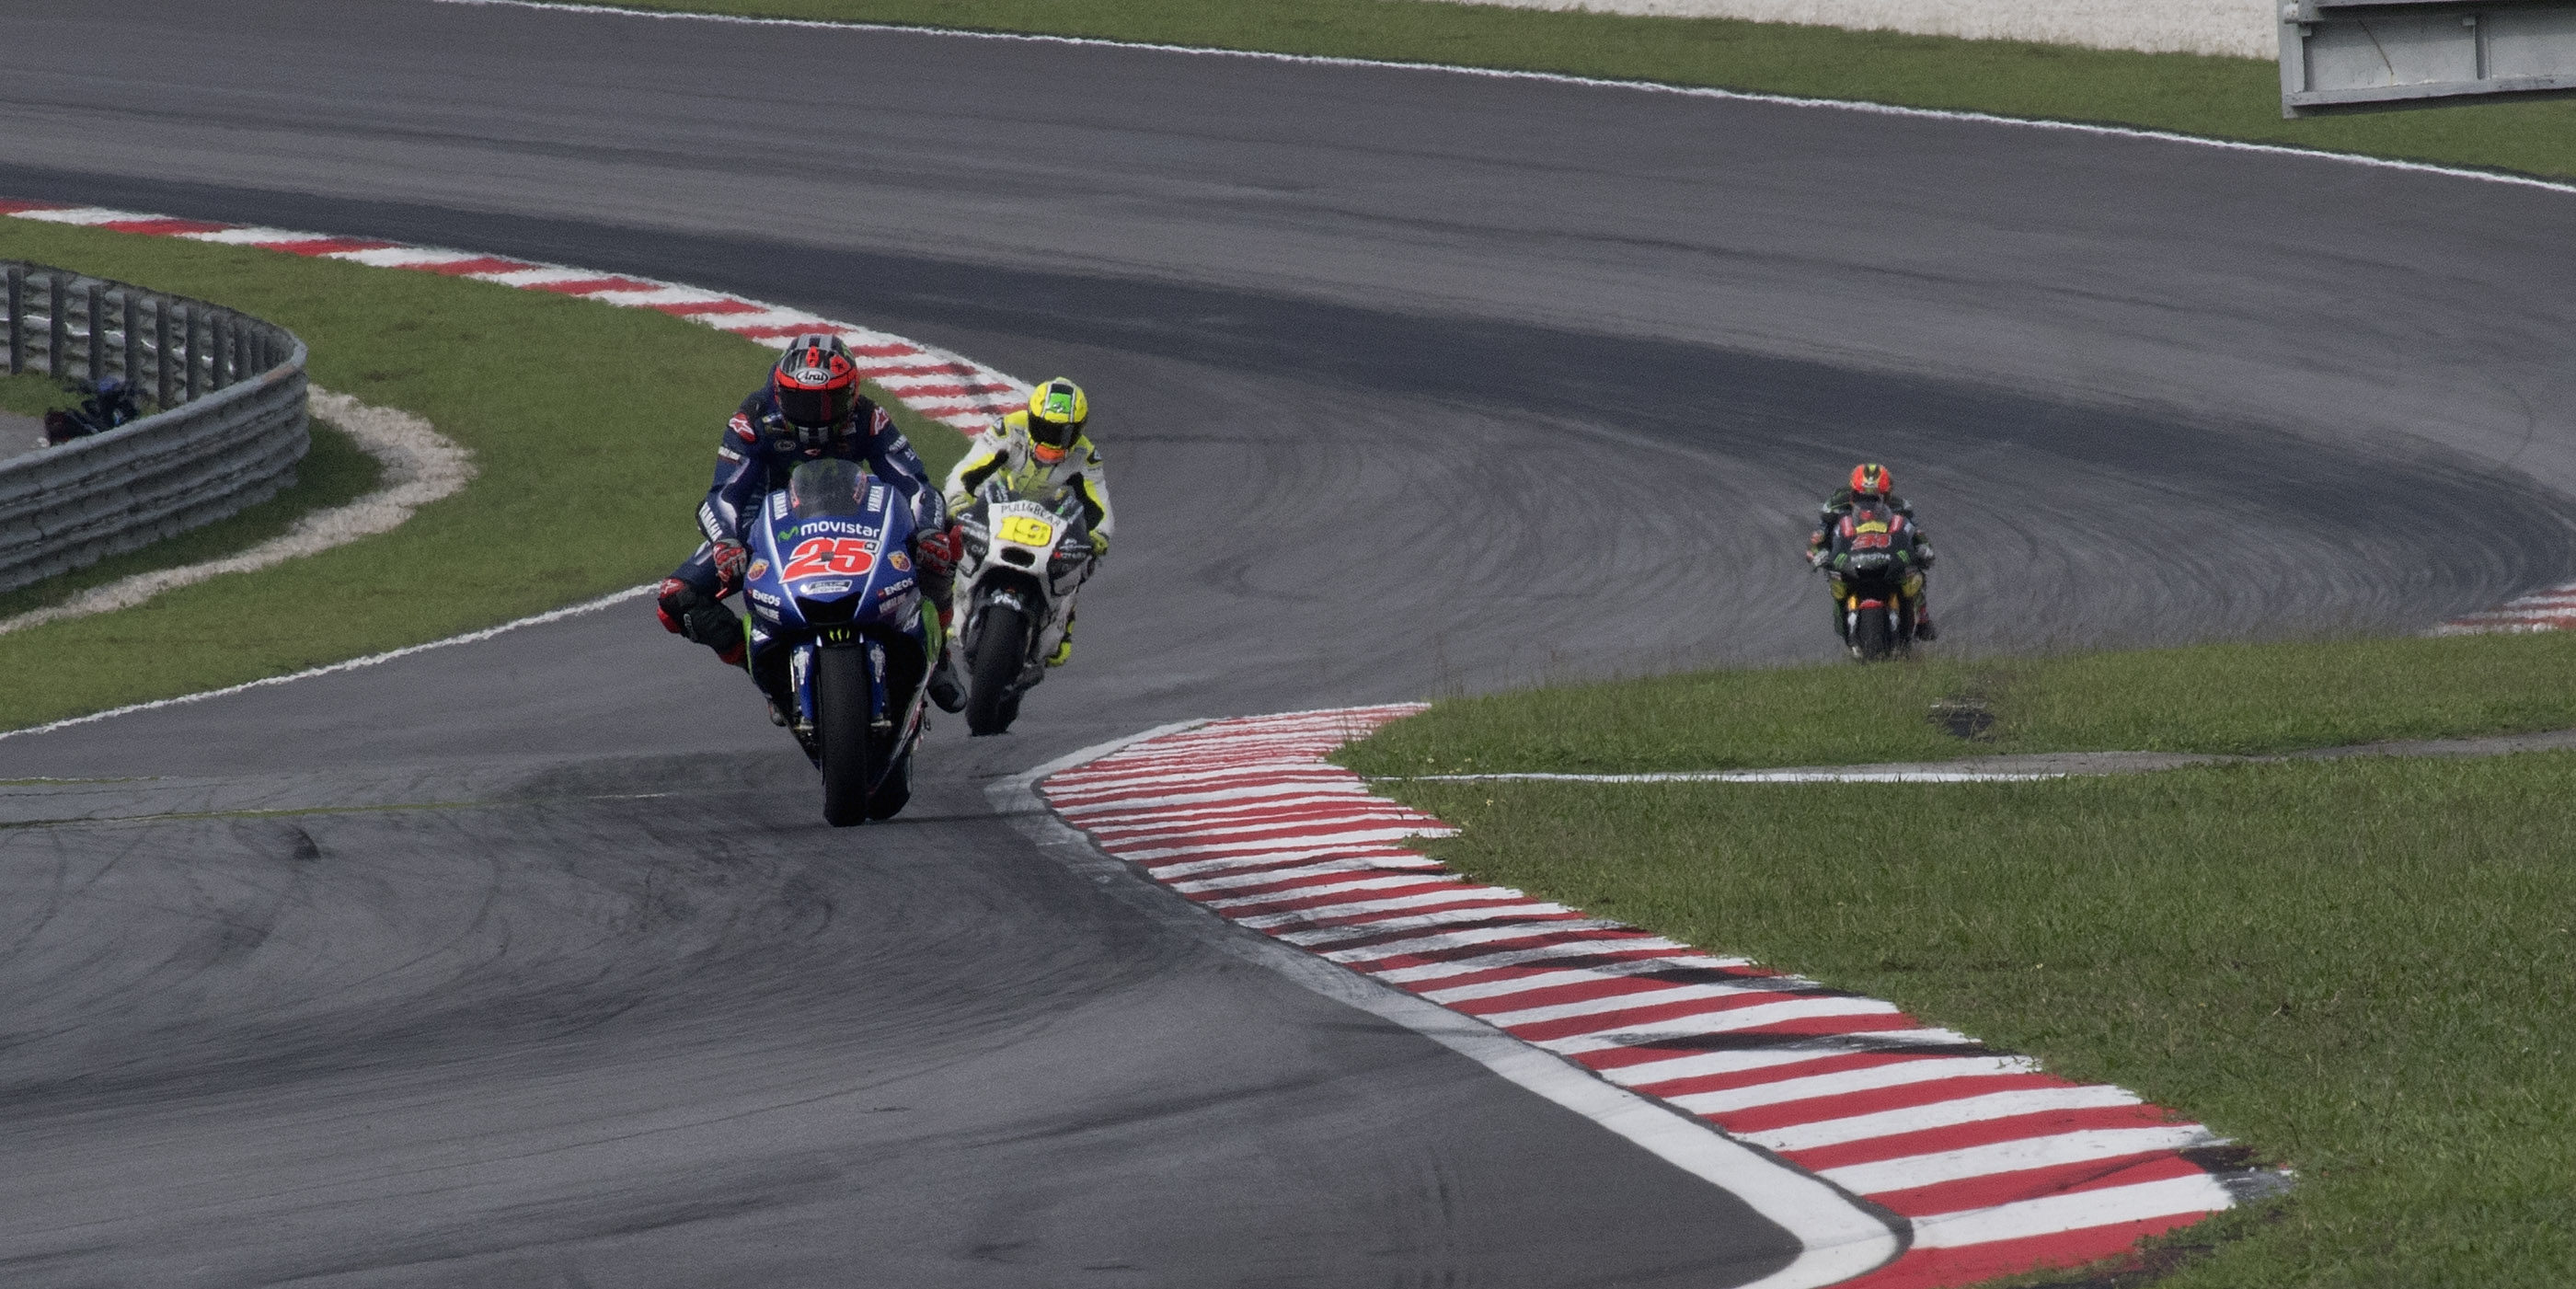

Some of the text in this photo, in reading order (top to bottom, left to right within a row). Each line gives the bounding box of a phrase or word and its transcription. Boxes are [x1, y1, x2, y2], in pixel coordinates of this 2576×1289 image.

[797, 371, 825, 382] Arai
[800, 521, 880, 537] movistar
[995, 515, 1053, 547] 19
[779, 536, 876, 584] 25
[884, 577, 914, 595] ENEOS
[752, 589, 781, 606] ENEOS
